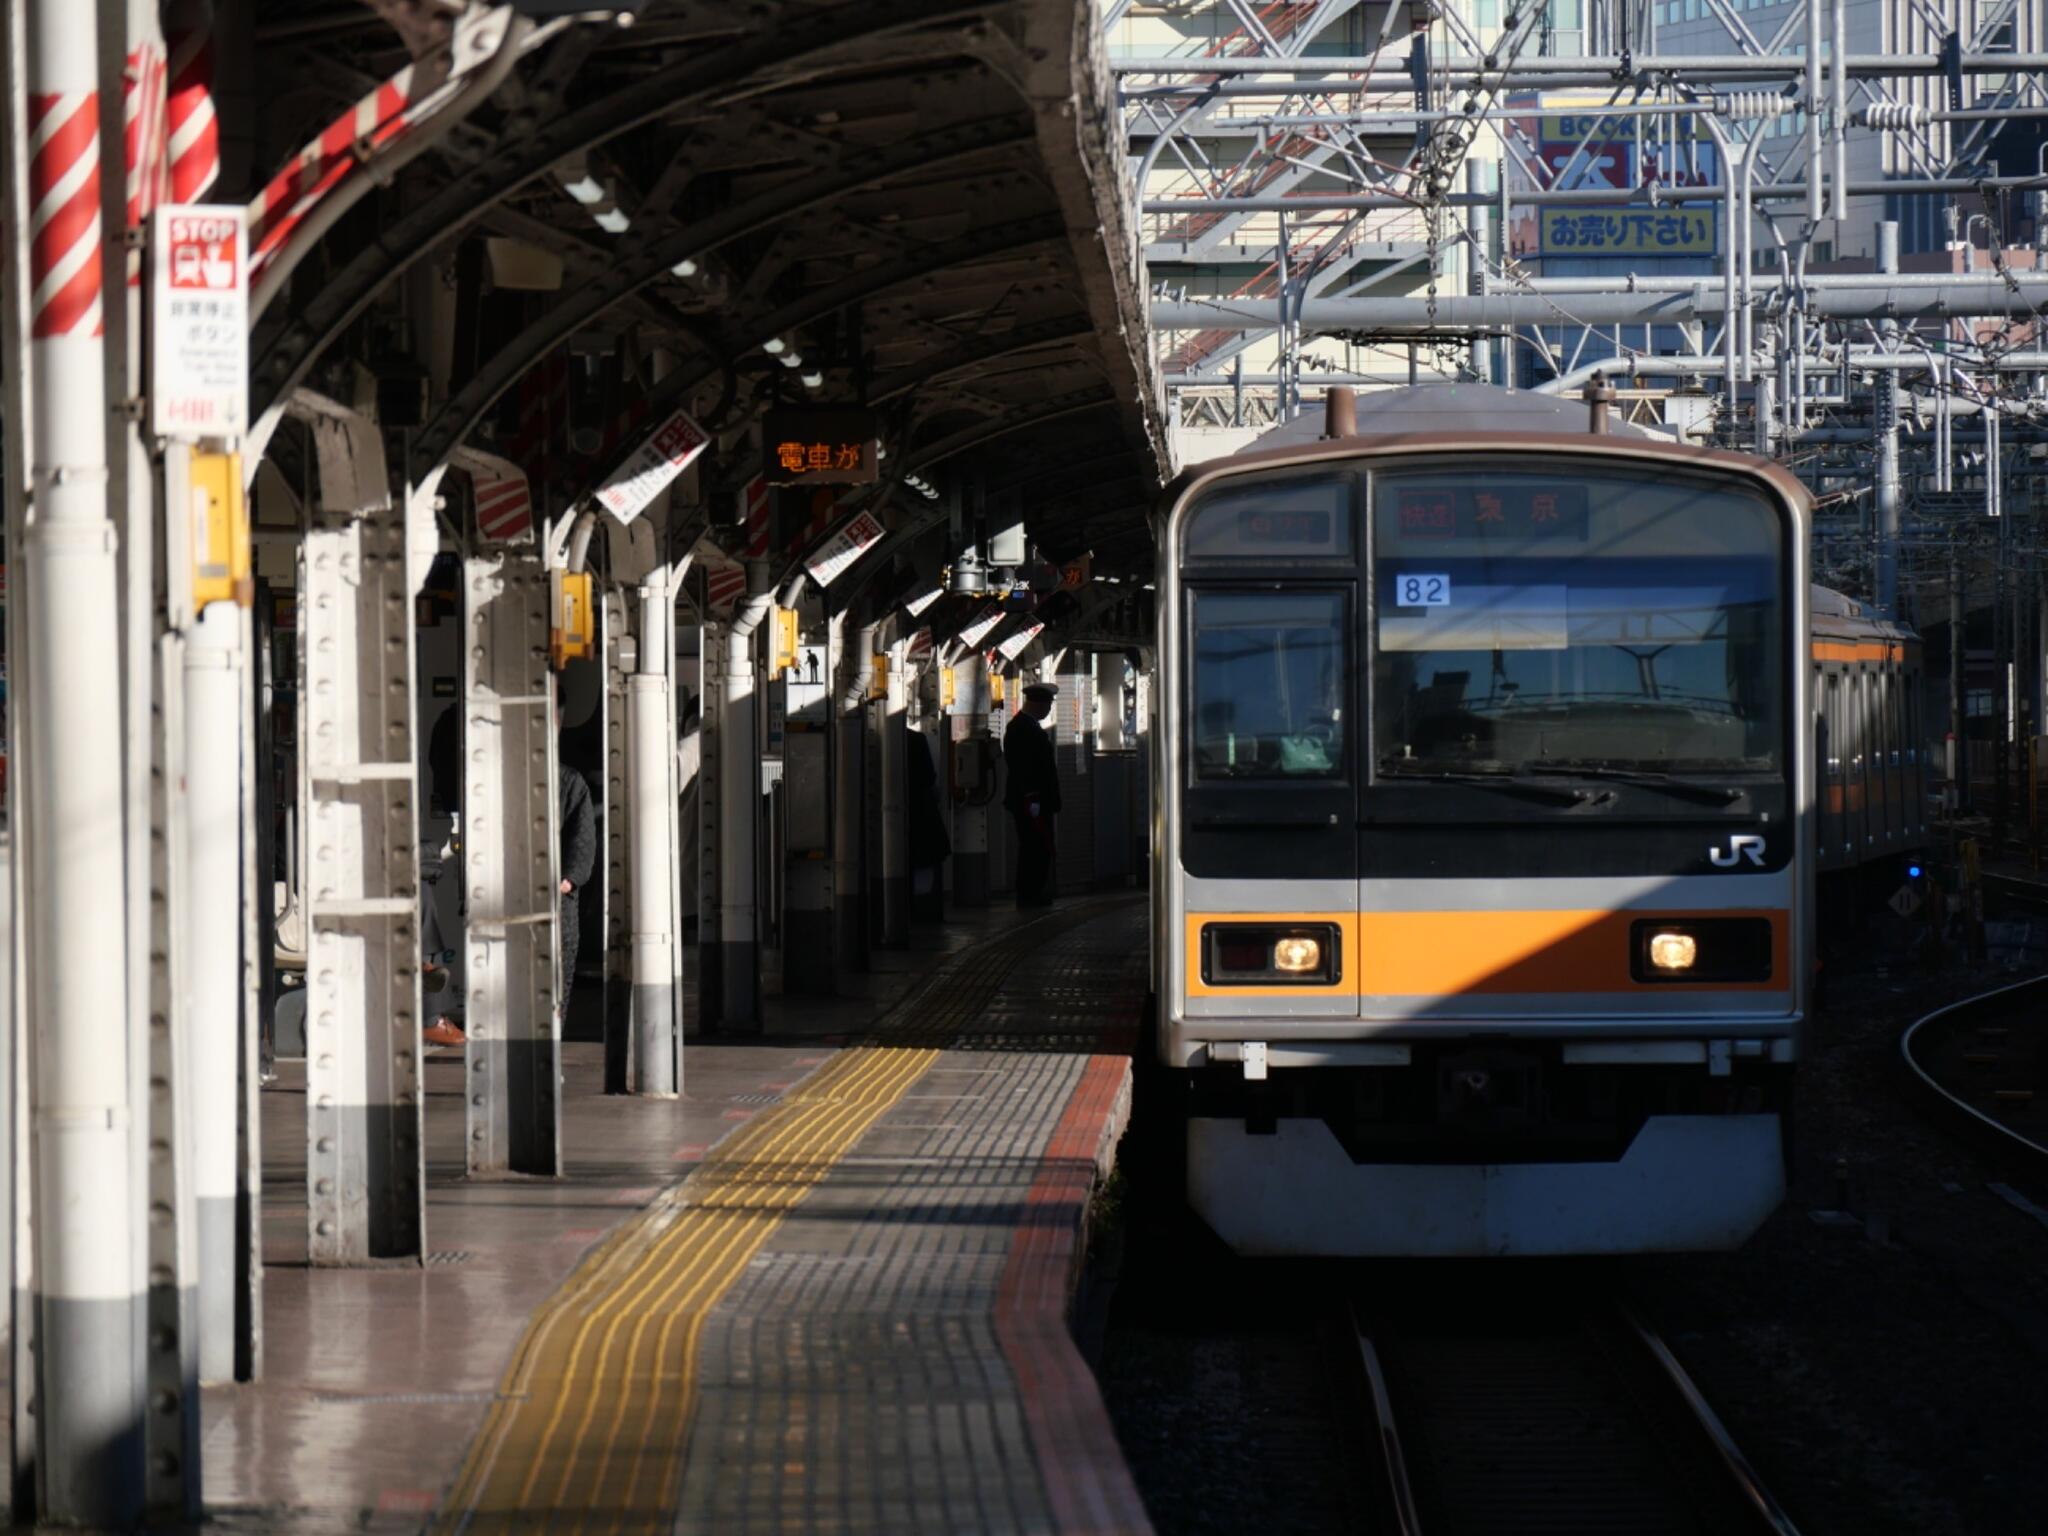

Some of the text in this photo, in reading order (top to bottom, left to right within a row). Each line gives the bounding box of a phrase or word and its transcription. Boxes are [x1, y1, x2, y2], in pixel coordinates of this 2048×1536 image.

[170, 218, 236, 243] STOP
[1551, 214, 1706, 246] お売り下さい
[777, 442, 860, 472] 電車が
[1405, 578, 1442, 603] 82
[1709, 835, 1767, 867] JR
